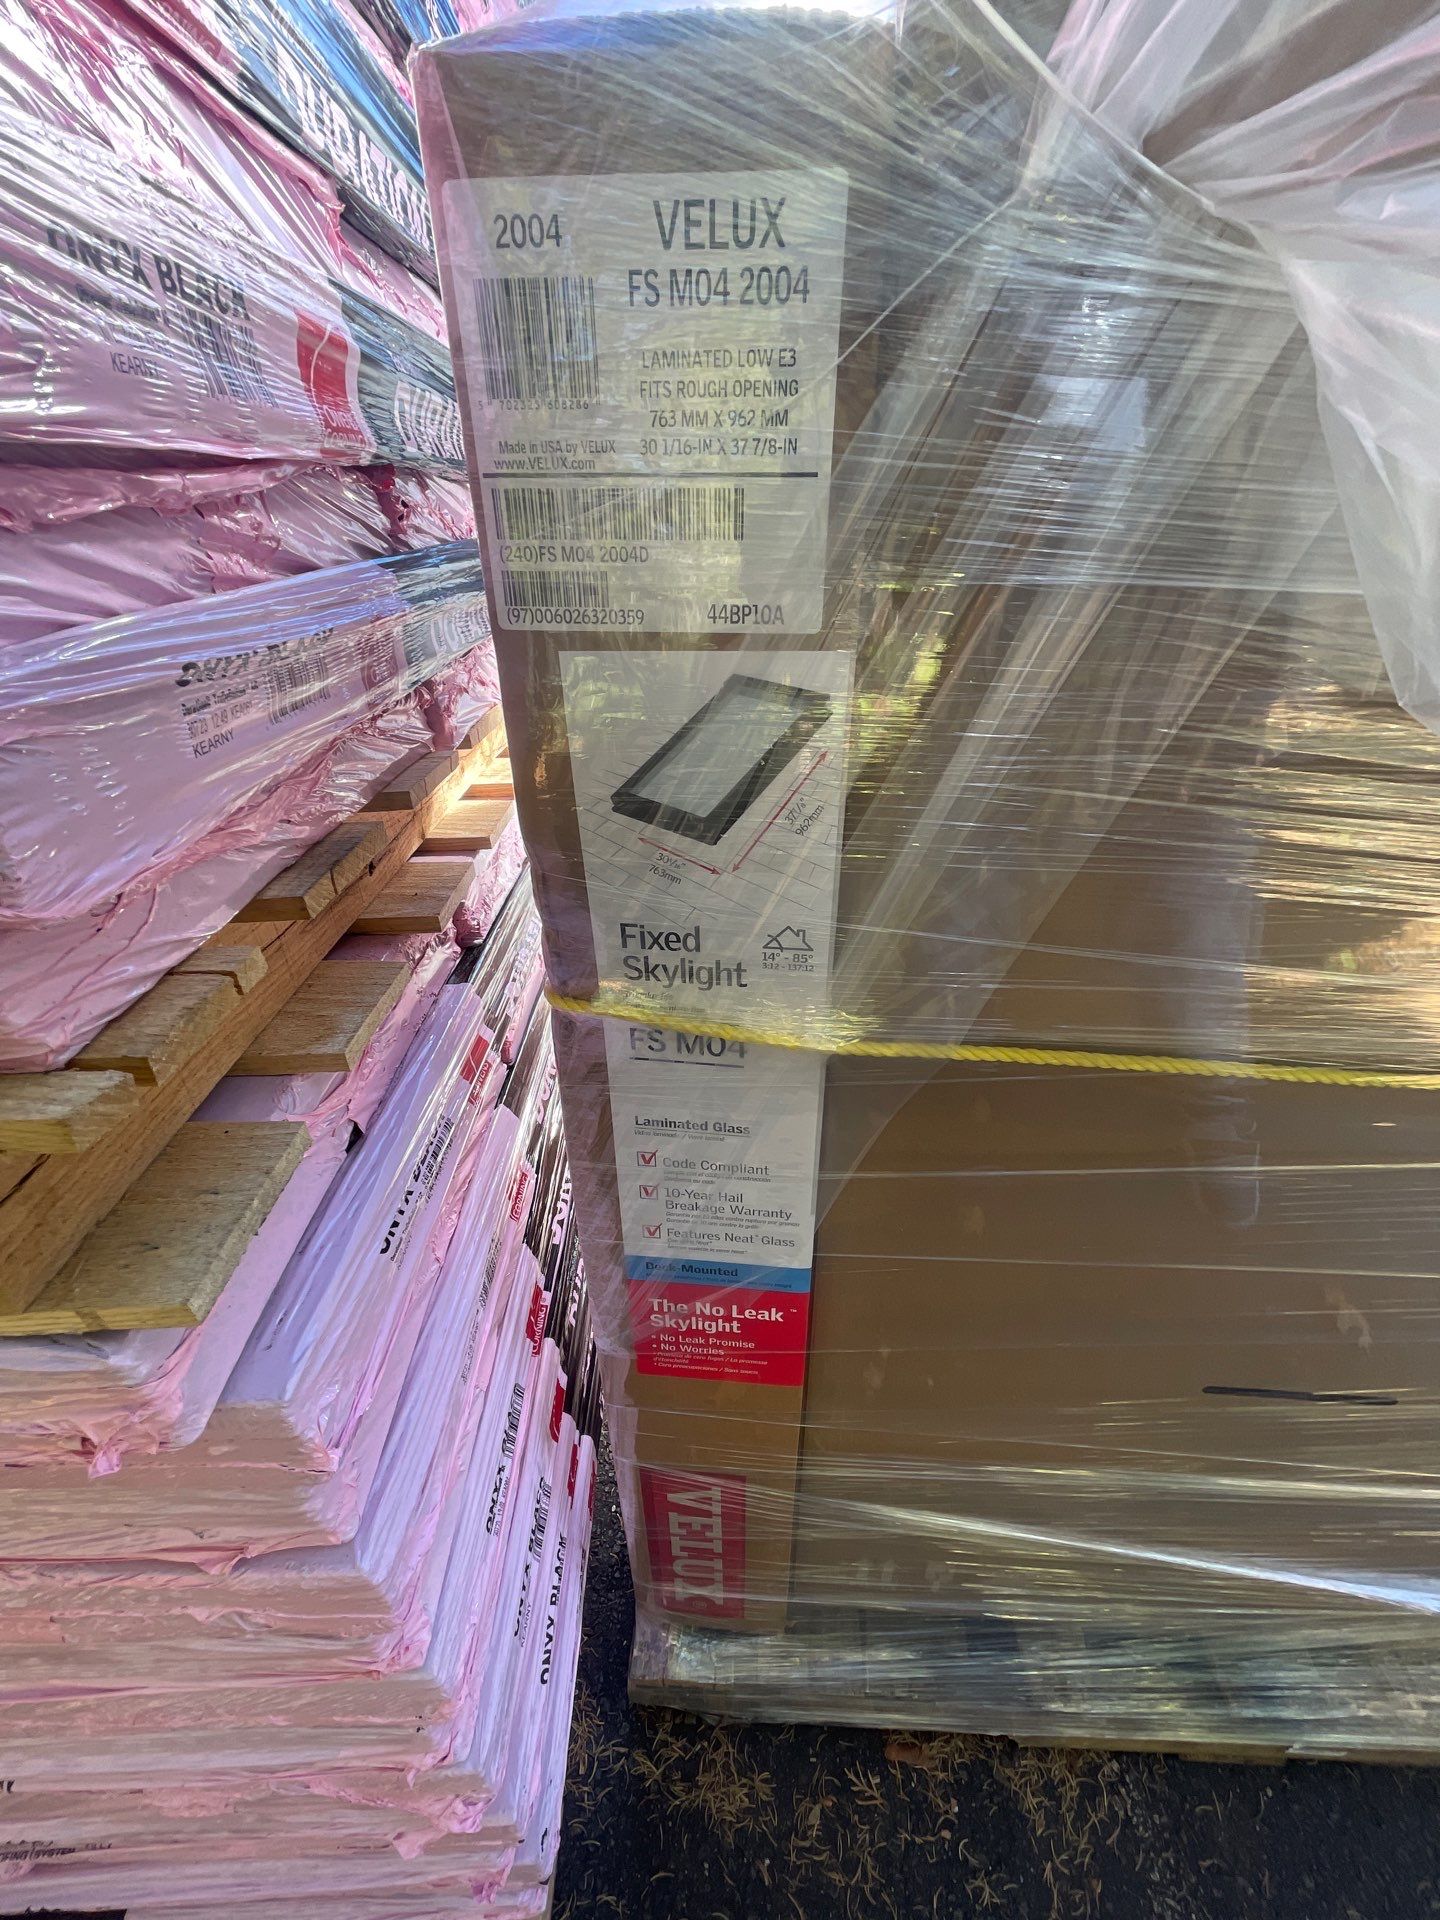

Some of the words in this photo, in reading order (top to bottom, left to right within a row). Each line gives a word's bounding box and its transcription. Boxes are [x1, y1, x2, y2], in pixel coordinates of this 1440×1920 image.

[493, 213, 563, 249] 2004
[653, 197, 787, 250] VELUX
[628, 268, 661, 307] FS
[669, 267, 731, 306] M04
[739, 265, 811, 305] 2004
[642, 350, 733, 369] LAMINATED
[737, 349, 774, 368] LOW
[778, 348, 797, 367] E3
[640, 380, 672, 398] FITS
[676, 380, 728, 398] ROUGH
[733, 379, 799, 397] OPENING
[650, 409, 677, 427] 763
[681, 409, 709, 427] MM
[713, 409, 723, 427] X
[728, 409, 756, 426] 962
[761, 408, 789, 427] MM
[498, 440, 526, 454] Made
[529, 440, 538, 454] in
[541, 440, 563, 454] USA
[566, 440, 578, 456] by
[580, 439, 616, 453] VELUX
[640, 438, 658, 455] 30
[717, 438, 727, 455] X
[730, 438, 749, 455] 37
[752, 437, 798, 456] 7/8-IN
[493, 456, 596, 470] www.VELUX.com
[500, 545, 558, 565] (240)FS
[562, 545, 595, 563] M04
[599, 545, 650, 563] 2004D
[507, 607, 645, 626] (97)006026320359
[707, 603, 785, 625] 44BP10A
[191, 728, 235, 759] KEARNY
[795, 803, 826, 837] 962mm
[648, 863, 683, 885] 763mm
[620, 922, 701, 953] Fixed
[762, 963, 780, 971] 3:12
[787, 964, 815, 972] 137:12
[792, 953, 814, 964] 85°
[622, 955, 748, 991] Skylight
[629, 1027, 667, 1052] FS
[634, 1115, 709, 1131] Laminated
[712, 1122, 751, 1135] Glass
[662, 1157, 696, 1169] Code
[700, 1160, 770, 1175] Compliant
[664, 1187, 713, 1200] 10-Year
[718, 1192, 743, 1203] Hail
[665, 1201, 725, 1214] Breakage
[730, 1205, 793, 1221] Warranty
[667, 1228, 721, 1241] Features
[761, 1235, 795, 1247] Glass
[651, 1298, 688, 1313] The
[695, 1301, 725, 1317] No
[732, 1304, 784, 1322] Leak
[650, 1314, 742, 1334] Skylight
[660, 1334, 676, 1343] No
[679, 1335, 705, 1345] Leak
[709, 1337, 755, 1349] Promise
[660, 1343, 676, 1352] No
[680, 1345, 725, 1356] Worries
[666, 1486, 725, 1606] VELUX
